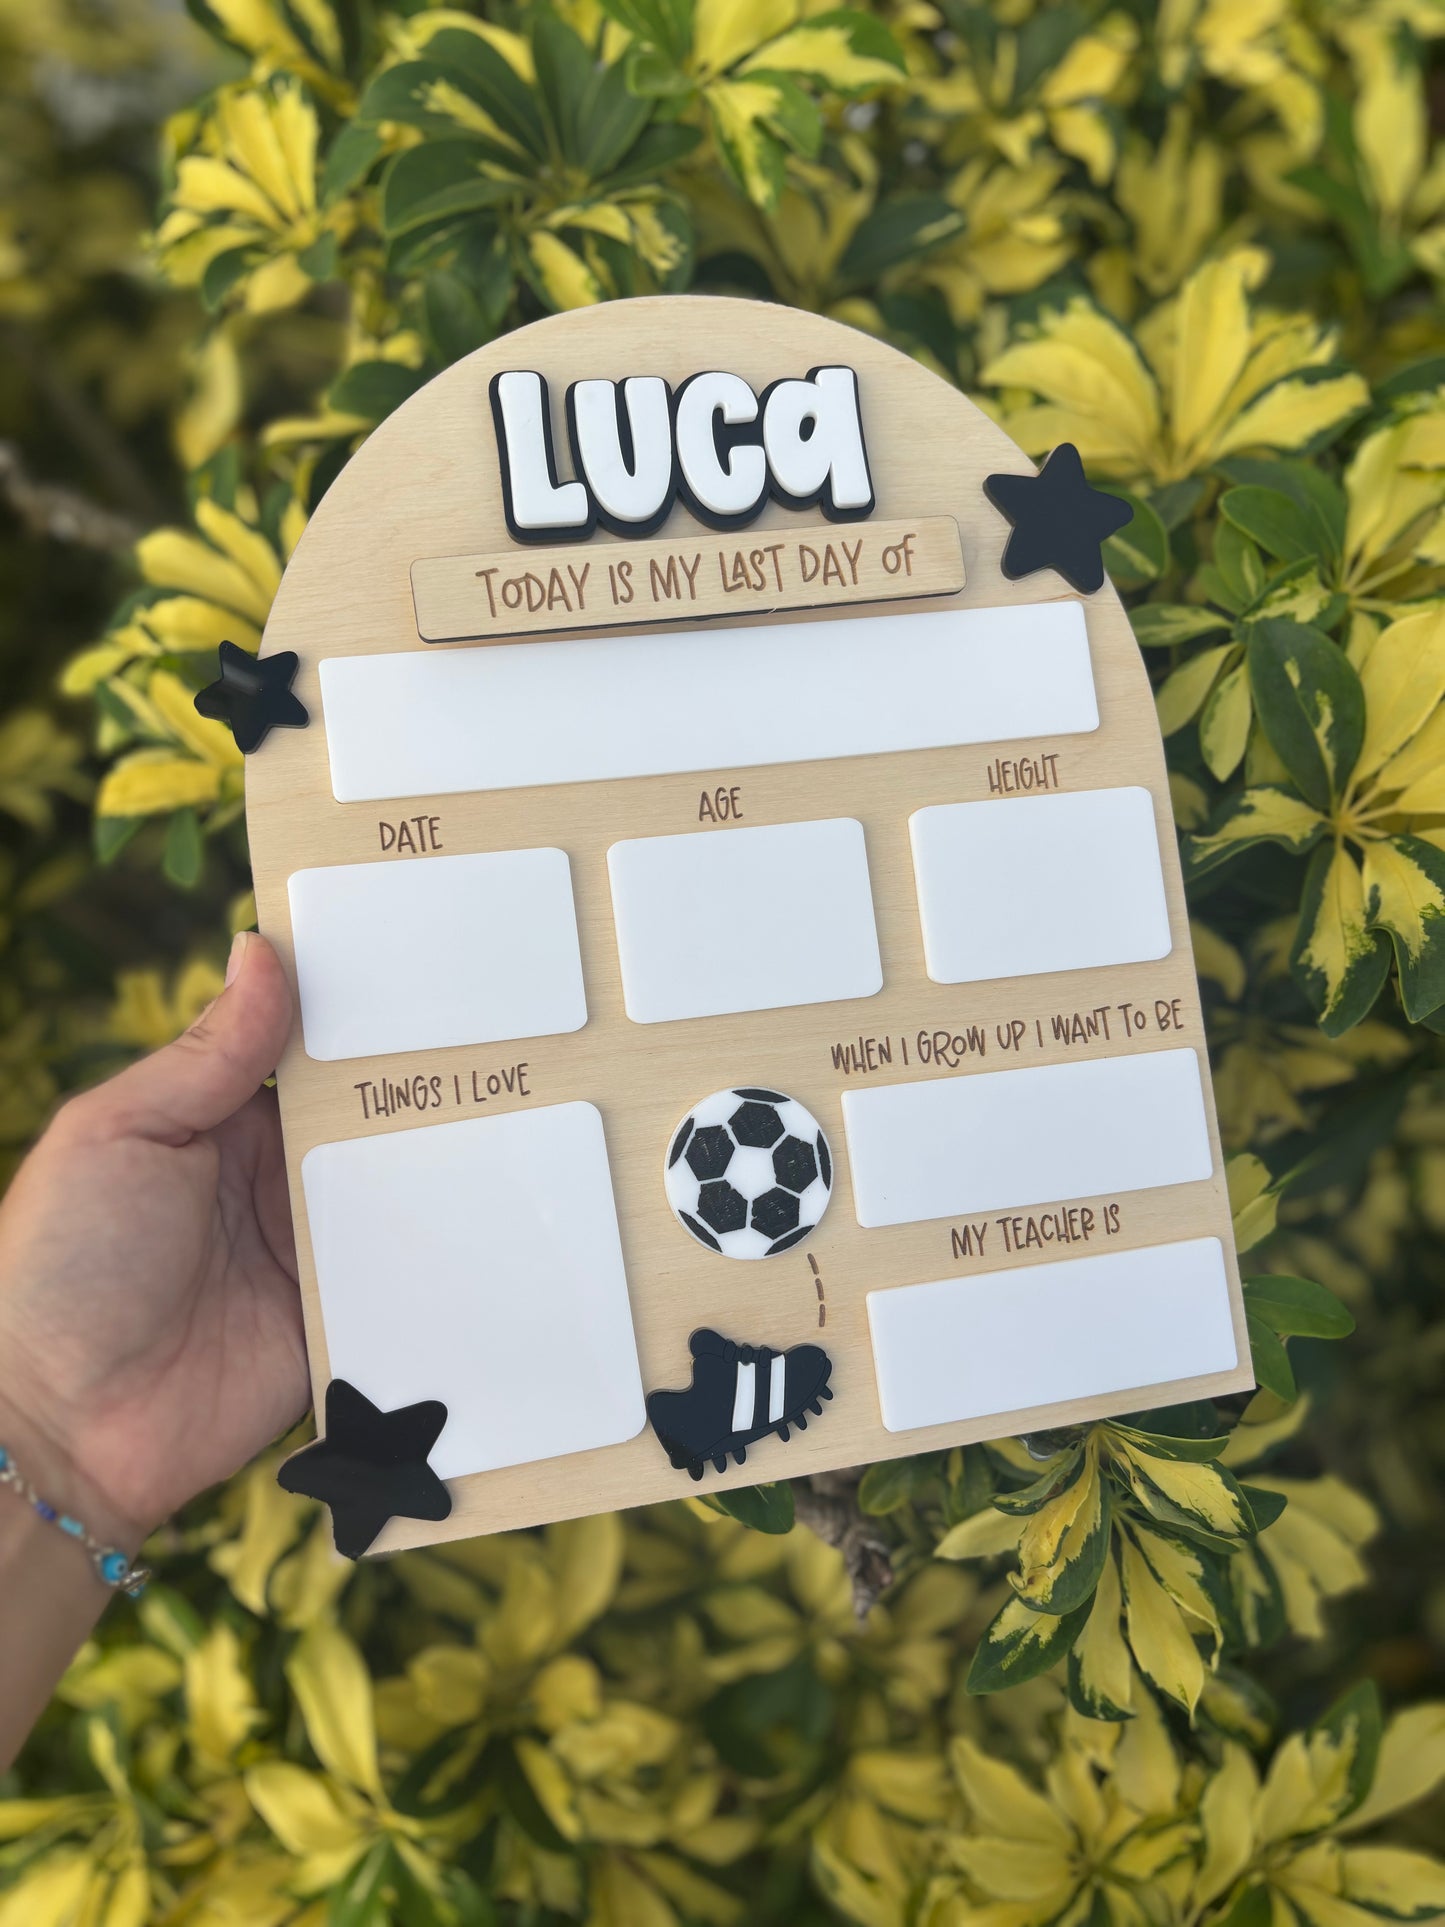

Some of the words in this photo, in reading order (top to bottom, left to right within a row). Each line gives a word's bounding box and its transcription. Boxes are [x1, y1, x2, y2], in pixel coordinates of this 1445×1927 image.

[475, 562, 590, 618] TODAY
[609, 560, 634, 605] IS
[650, 553, 701, 602] MY
[719, 544, 785, 592] LAST
[798, 538, 863, 587] DAY
[987, 753, 1060, 794] HEIGHT
[699, 786, 744, 822] AGE
[379, 815, 443, 854] DATE
[831, 1036, 892, 1075] WHEN
[901, 1037, 909, 1066] I
[917, 1025, 986, 1068] GROW
[996, 1019, 1026, 1051] UP
[1036, 1019, 1043, 1048] I
[1051, 1006, 1111, 1045] WANT
[1117, 1003, 1146, 1037] TO
[1155, 998, 1184, 1031] BE
[354, 1075, 442, 1119] THINGS
[453, 1074, 461, 1105] I
[472, 1062, 531, 1102] LOVE
[952, 1222, 987, 1259] MY
[996, 1206, 1095, 1252] TEACHER
[1103, 1203, 1120, 1235] IS
